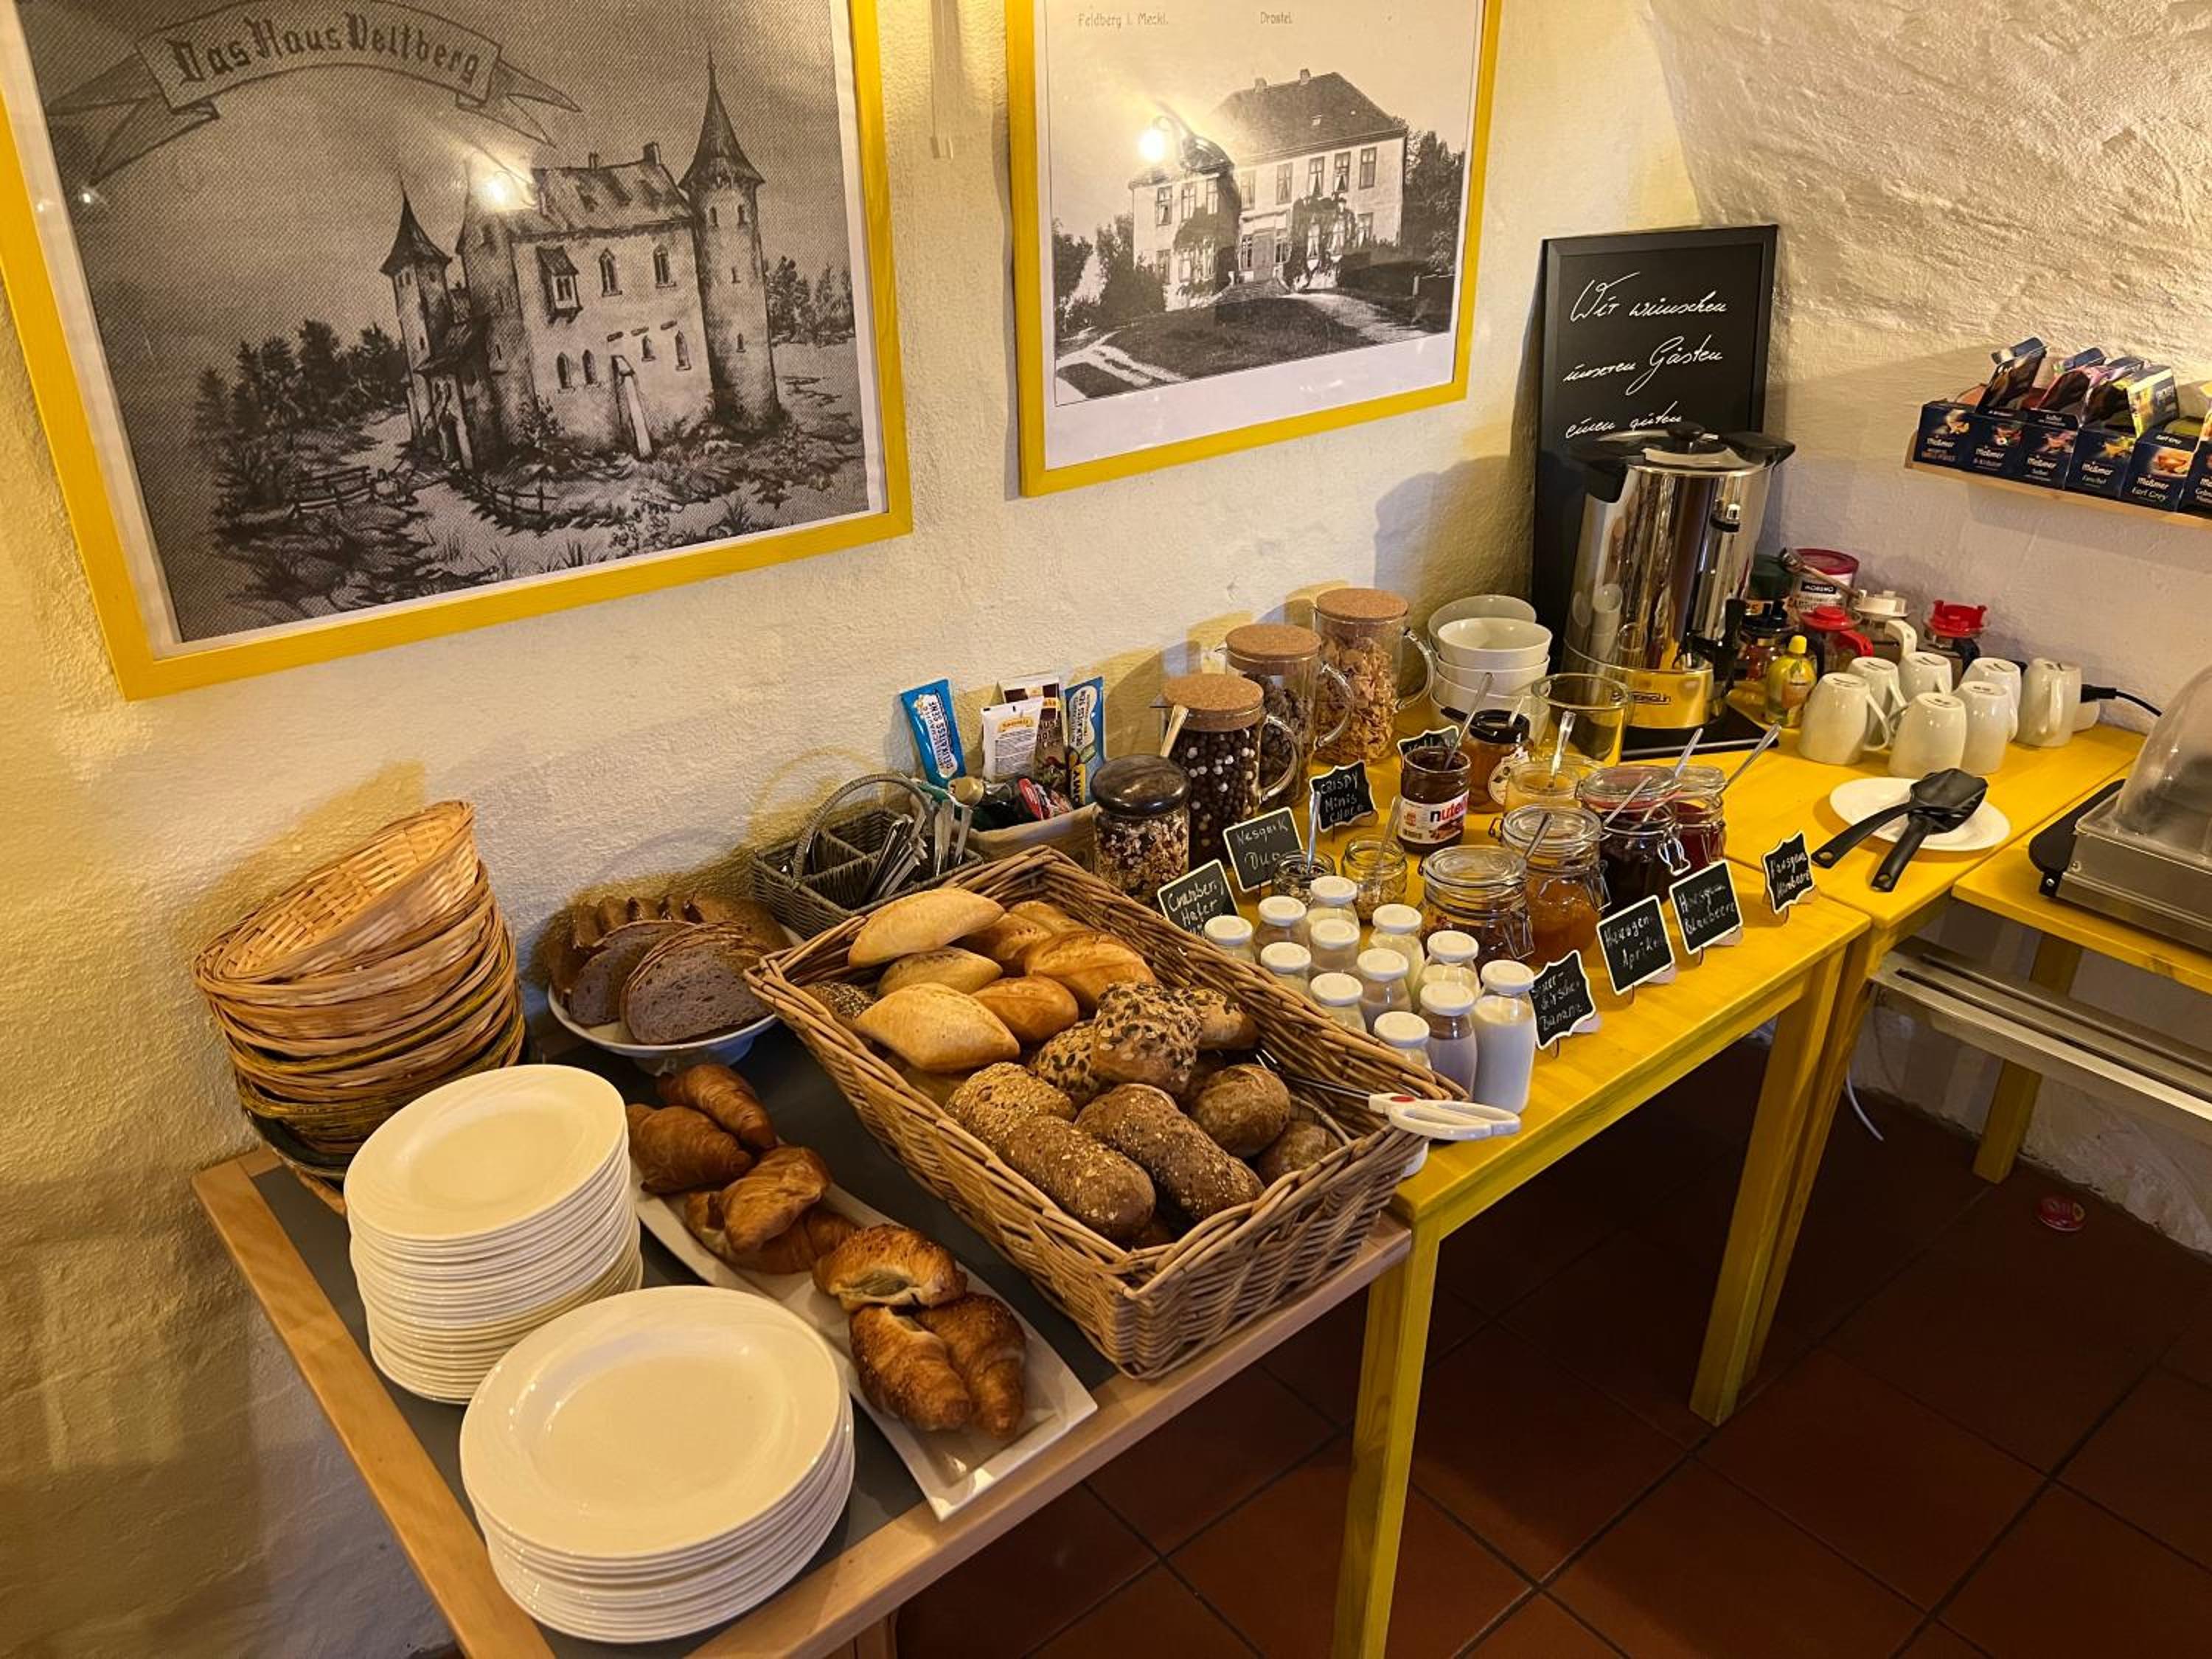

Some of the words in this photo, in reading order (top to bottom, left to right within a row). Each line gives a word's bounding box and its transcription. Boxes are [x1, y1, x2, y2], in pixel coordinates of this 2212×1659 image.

[165, 38, 251, 86] Das
[244, 17, 341, 59] Haus
[1571, 271, 1640, 322] Wir
[1626, 335, 1723, 395] Gästen
[1565, 417, 1615, 439] einen
[1321, 771, 1358, 794] CRISPY
[1181, 899, 1217, 926] Hafer
